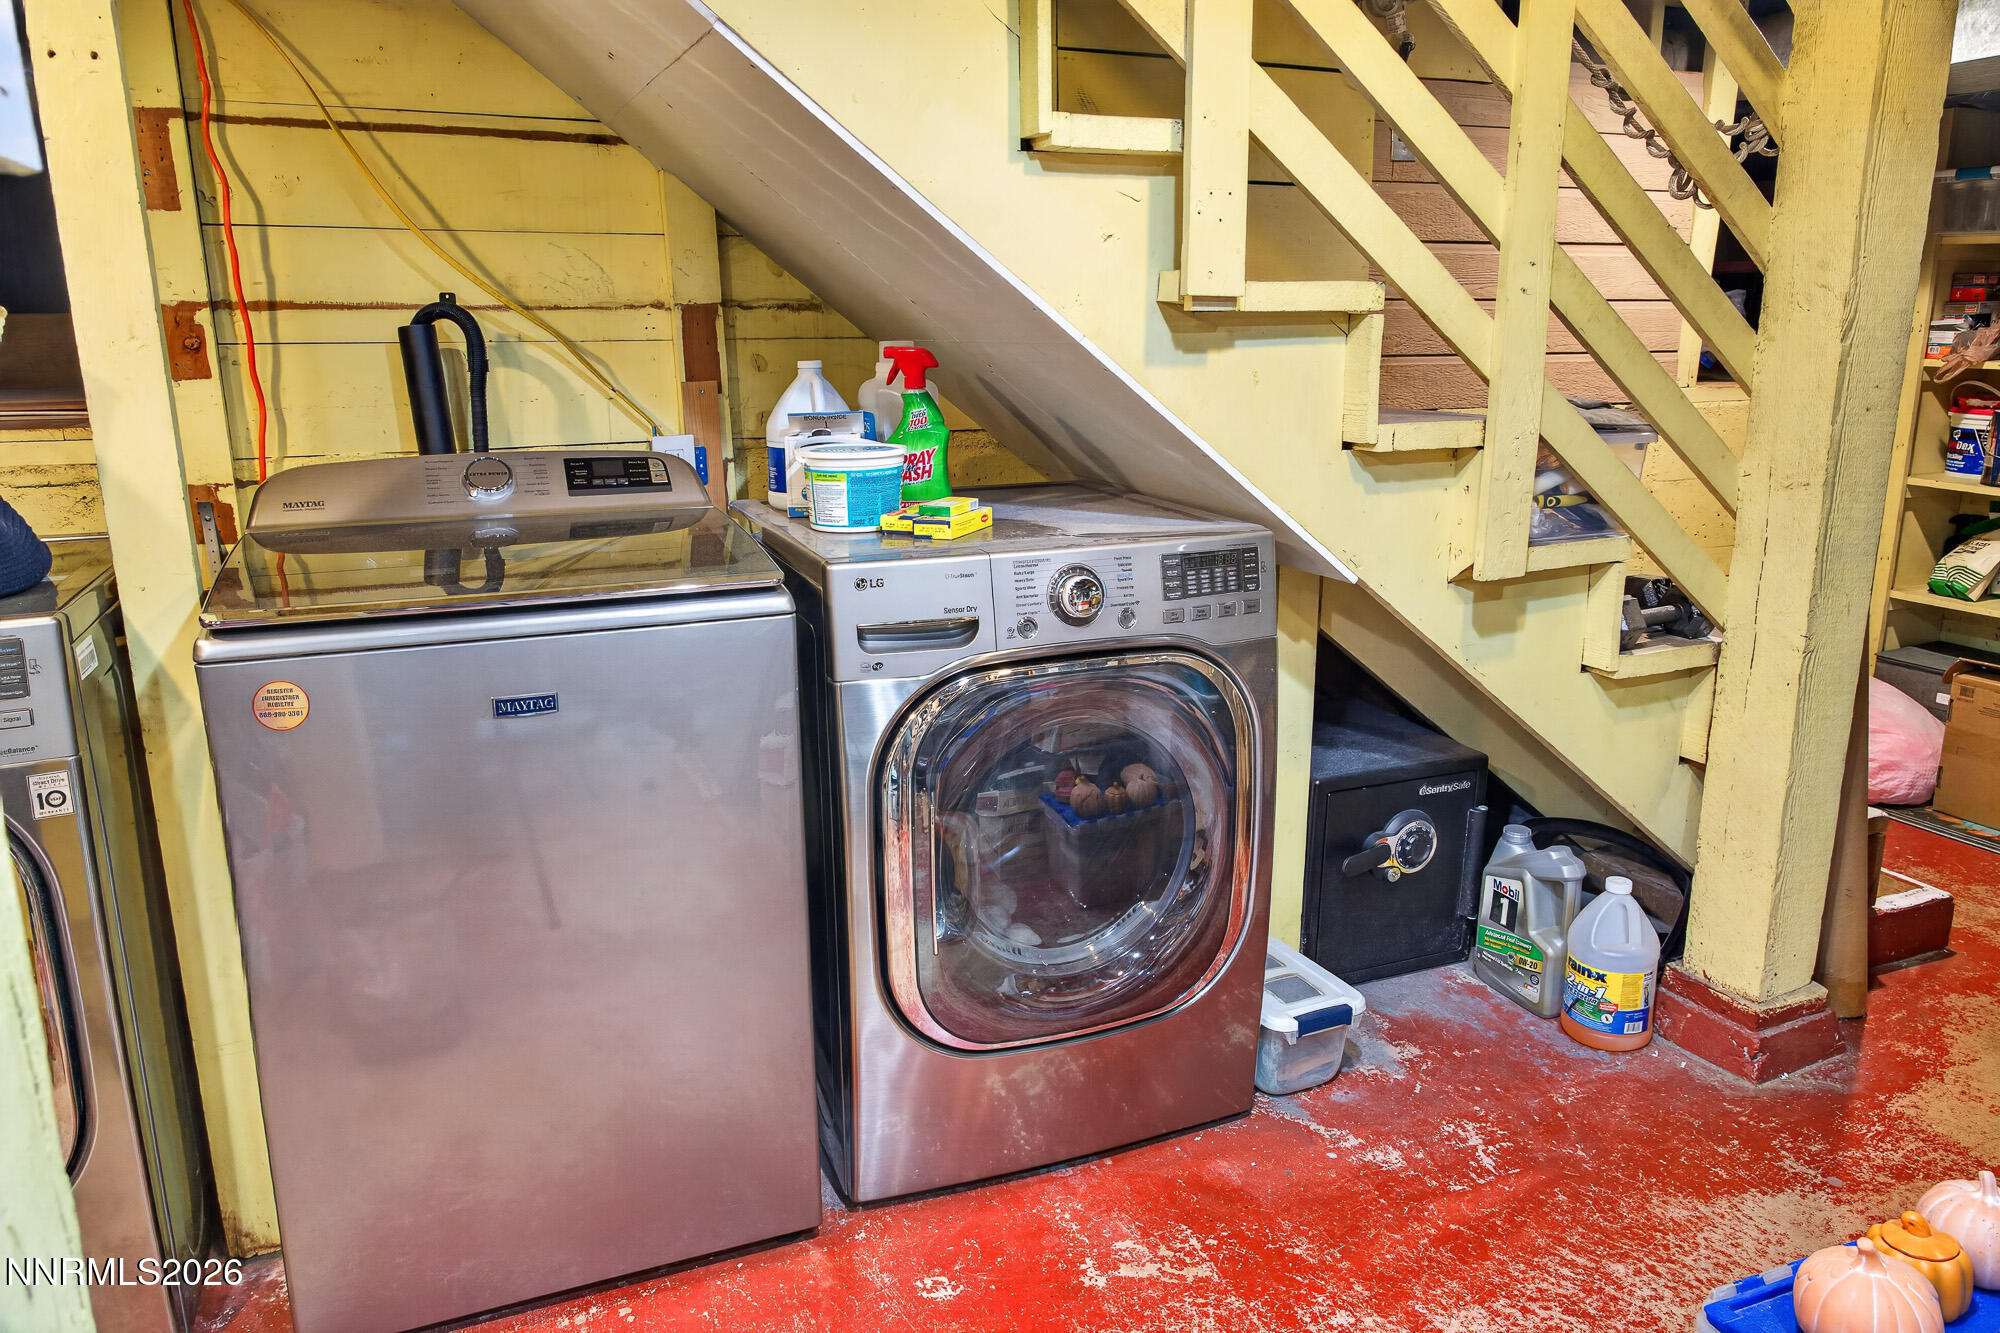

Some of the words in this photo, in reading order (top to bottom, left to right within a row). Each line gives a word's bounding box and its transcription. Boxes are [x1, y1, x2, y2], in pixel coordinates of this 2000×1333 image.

[909, 416, 928, 427] 100
[903, 447, 936, 467] PRAY
[901, 464, 933, 482] ASH
[282, 500, 325, 509] MAYTAG
[869, 578, 884, 588] LG
[943, 606, 966, 614] Sensor
[966, 605, 978, 613] Dry
[497, 697, 555, 713] MAYTAG
[1425, 781, 1471, 795] SentrySafe
[36, 790, 67, 810] 10
[1493, 878, 1520, 902] Mobil
[1500, 897, 1510, 926] 1
[1518, 956, 1538, 970] 0W-20
[1567, 971, 1608, 1000] 2-in-1
